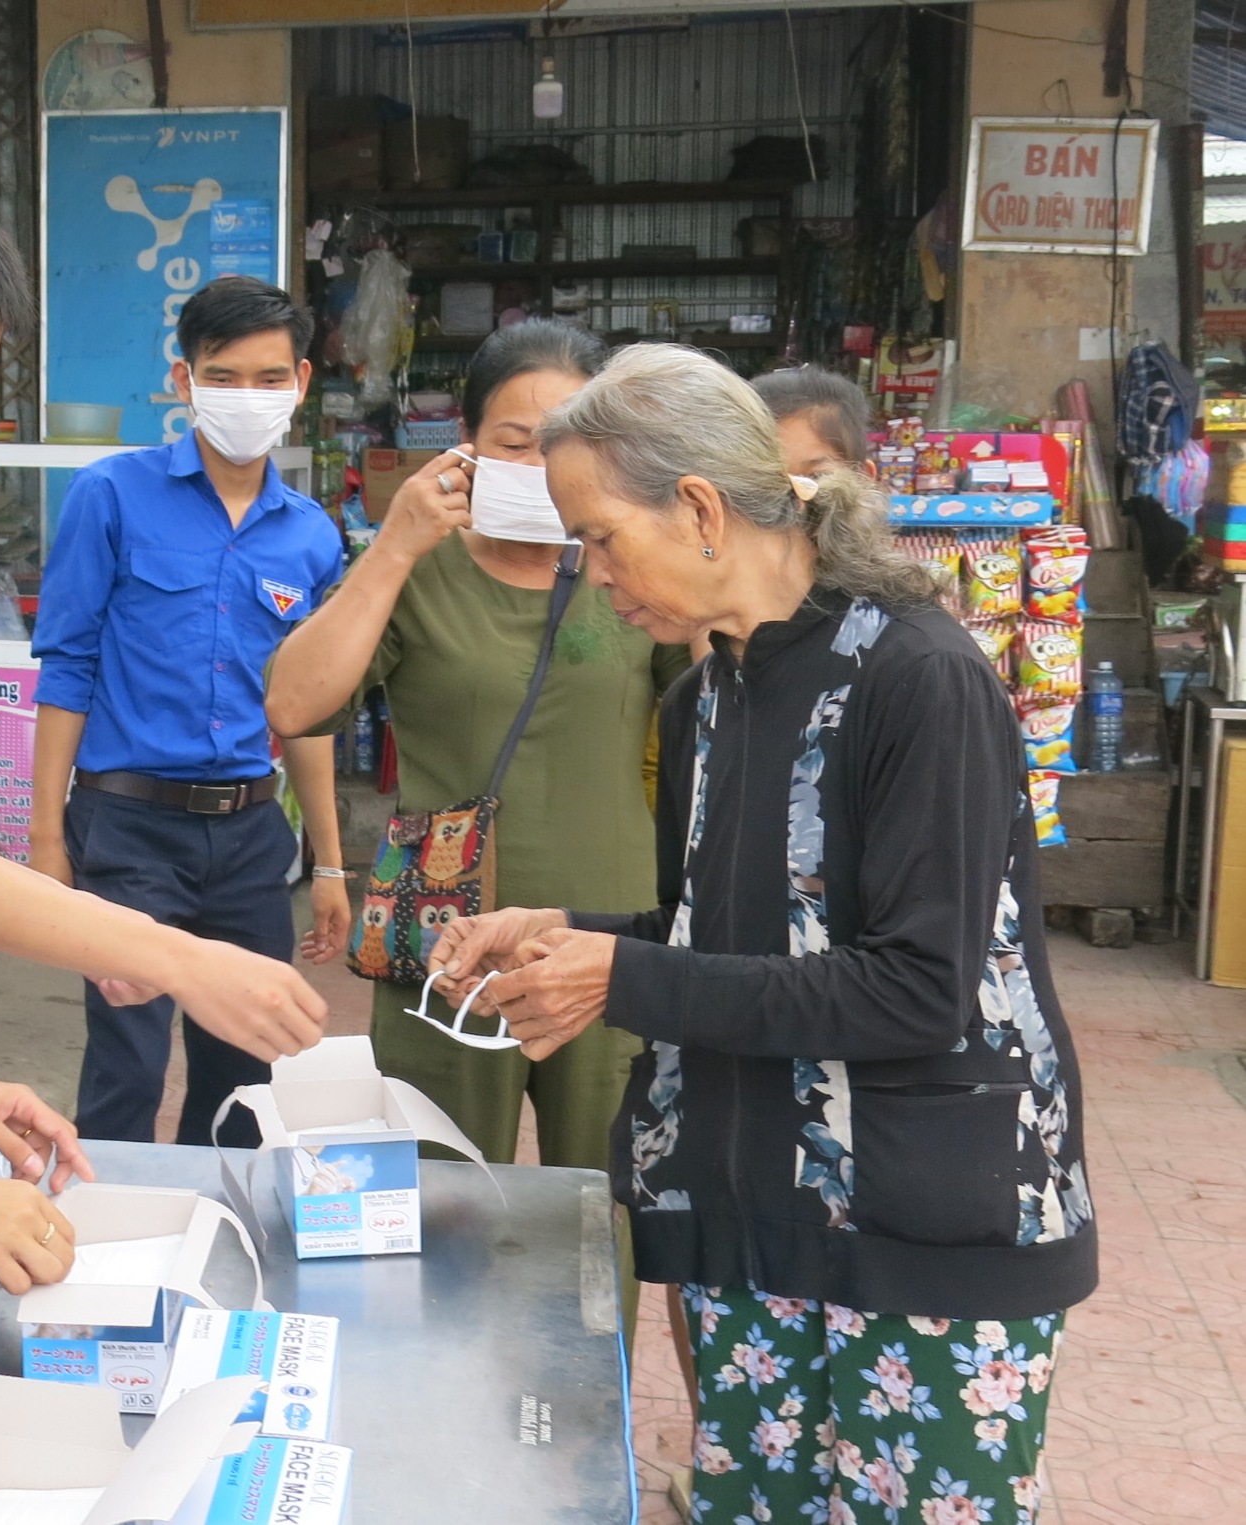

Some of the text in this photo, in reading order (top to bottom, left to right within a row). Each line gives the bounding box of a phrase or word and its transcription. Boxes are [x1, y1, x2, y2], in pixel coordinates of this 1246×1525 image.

[181, 130, 240, 143] VNPT
[1024, 136, 1100, 178] BÁN
[282, 1316, 306, 1345] FACE
[276, 1345, 302, 1378] MASK
[284, 1444, 314, 1481] FACE
[274, 1482, 307, 1525] MASK
